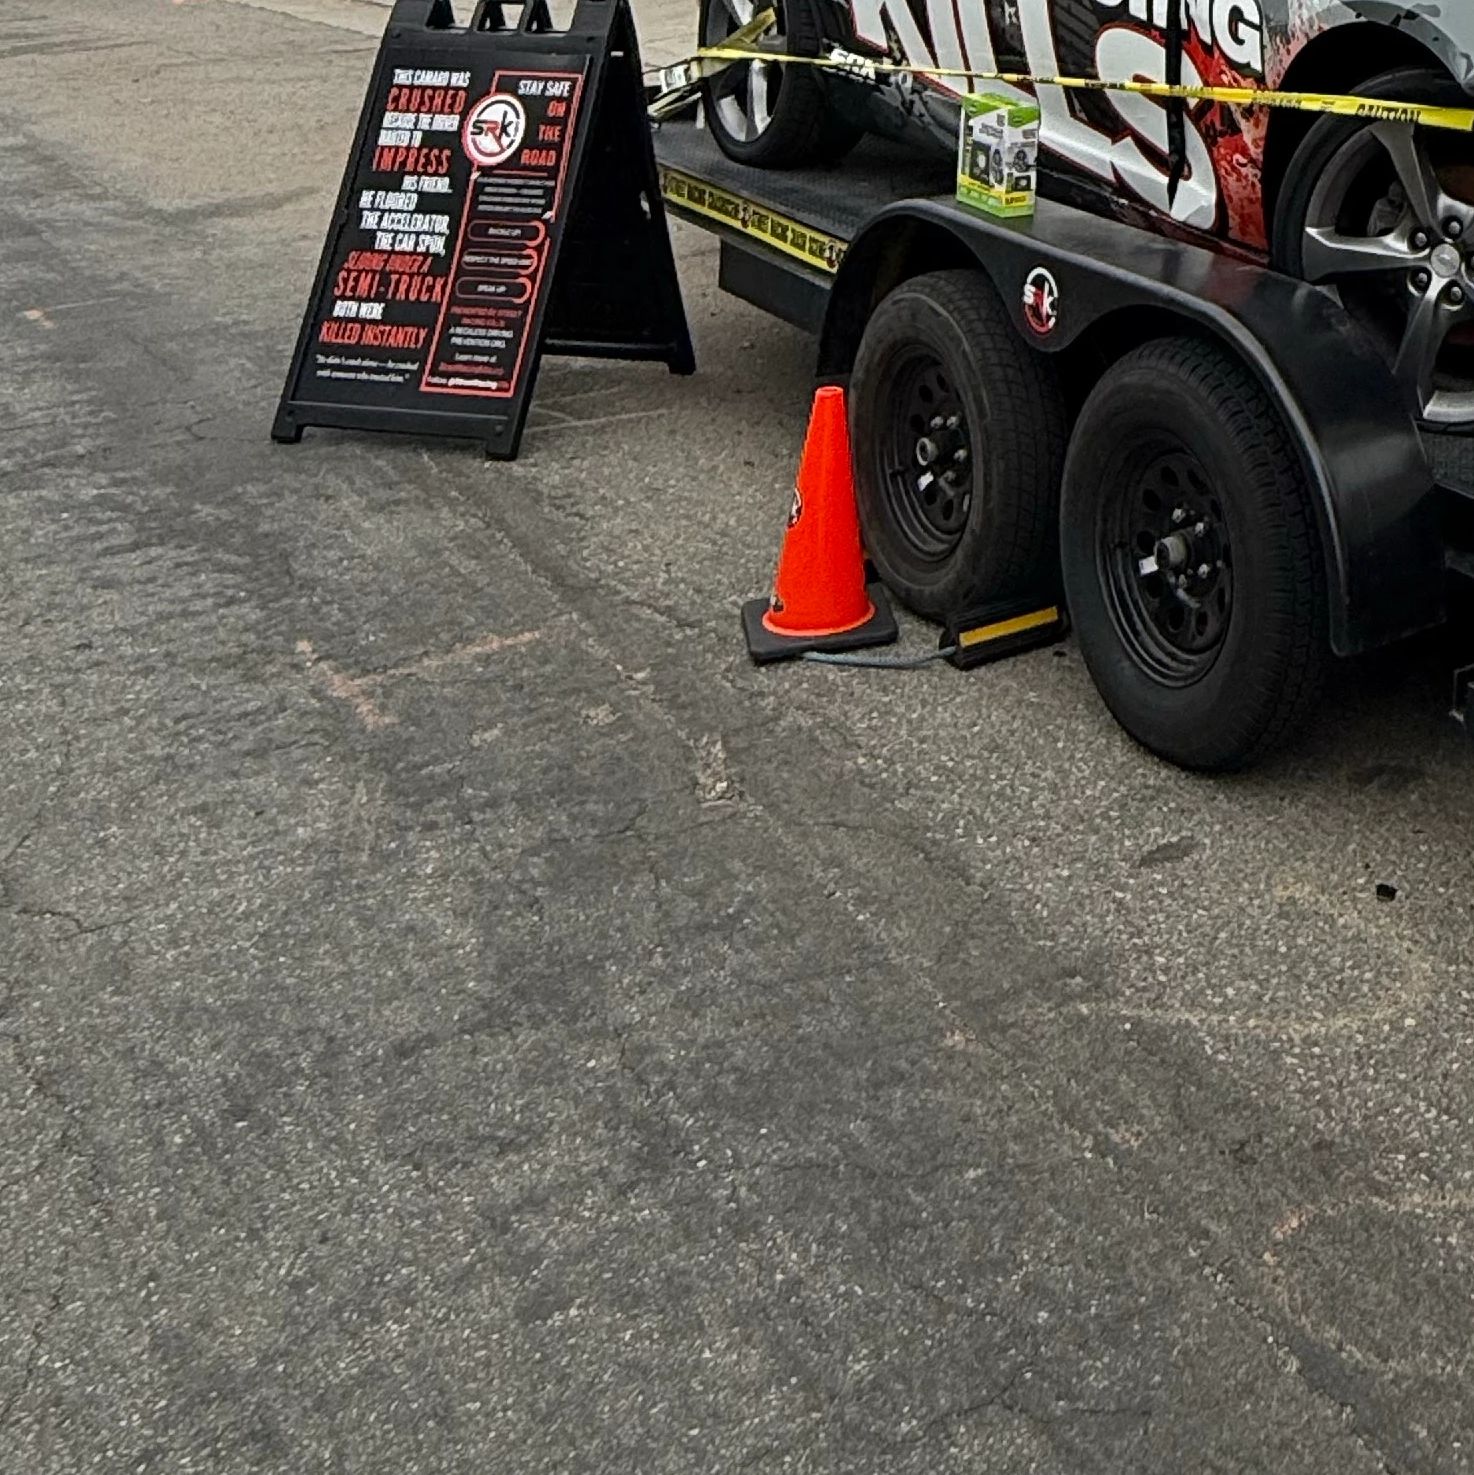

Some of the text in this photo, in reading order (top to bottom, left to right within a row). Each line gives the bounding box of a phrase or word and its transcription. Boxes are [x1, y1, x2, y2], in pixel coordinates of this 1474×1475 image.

[518, 80, 572, 97] STAY SAFE
[386, 87, 468, 114] CRUSHED
[538, 124, 562, 142] THE
[372, 146, 452, 174] IMPRESS
[521, 149, 557, 166] ROAD
[394, 233, 416, 252] CAR
[333, 270, 446, 303] SEMI-TRUCK
[359, 302, 385, 319] WERE
[319, 321, 428, 348] KILLED INSTANTLY
